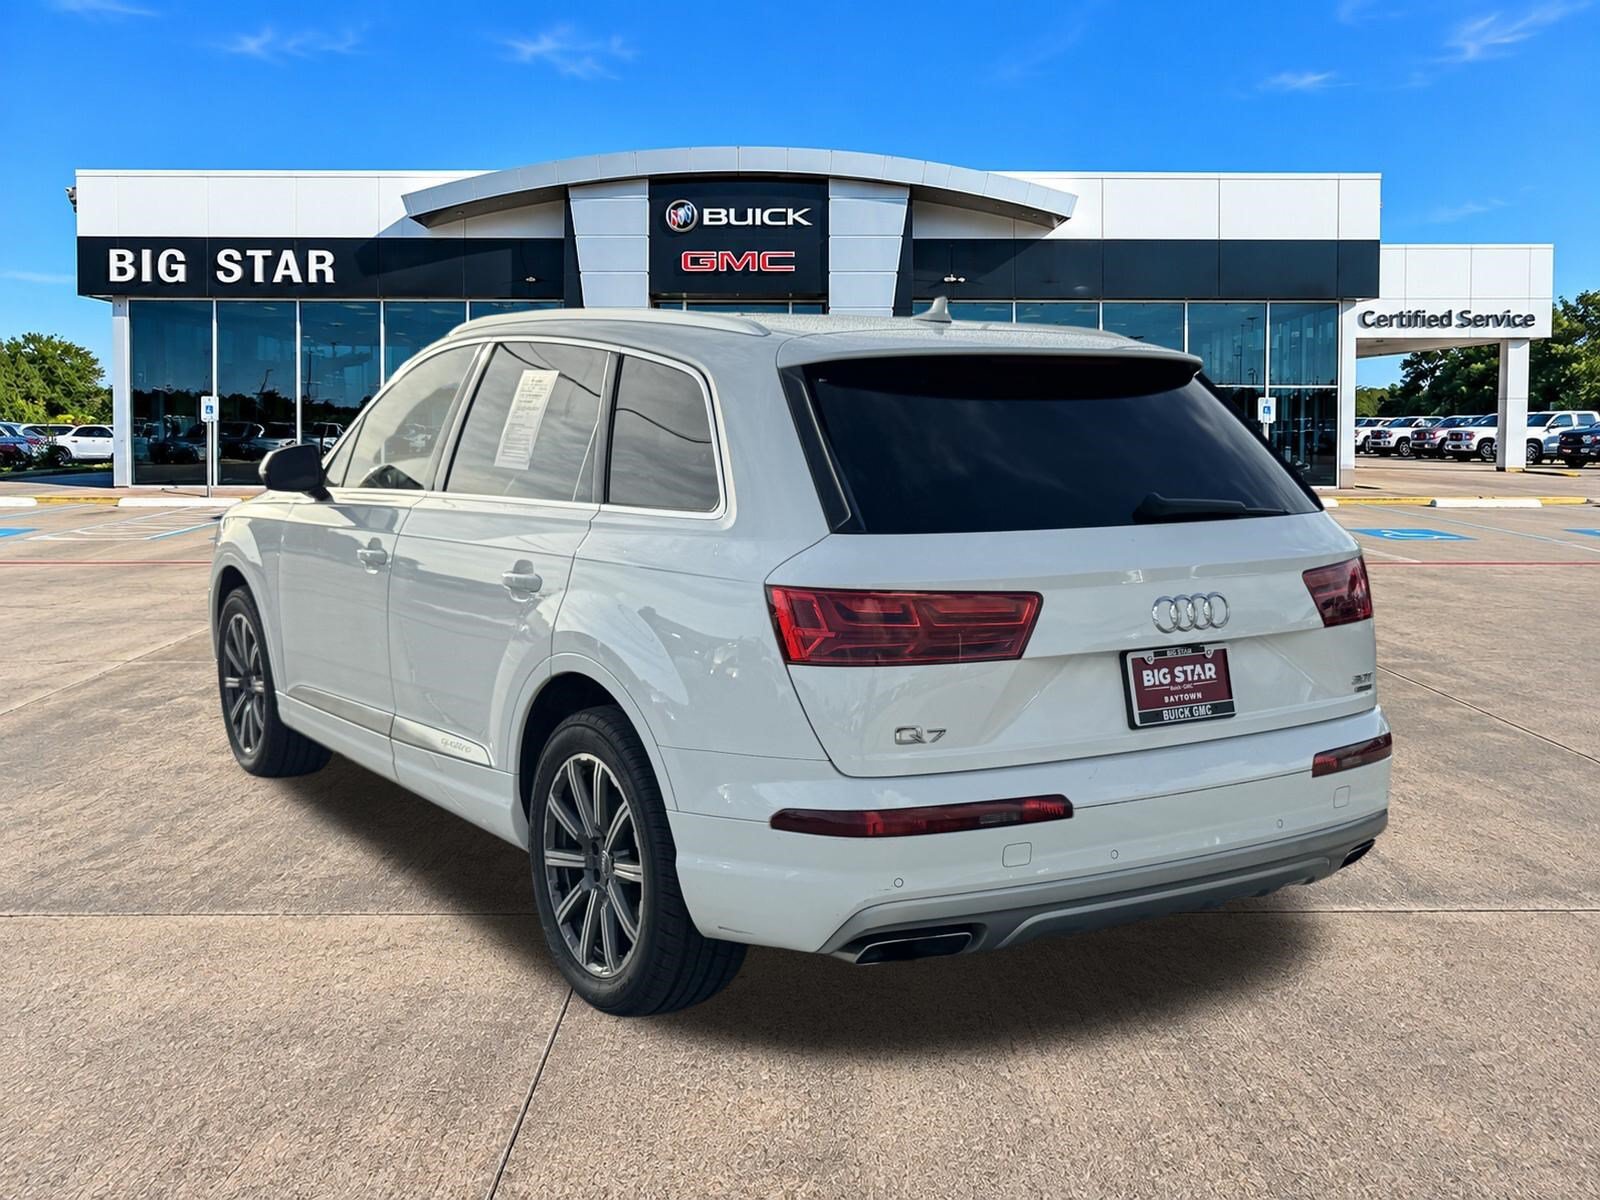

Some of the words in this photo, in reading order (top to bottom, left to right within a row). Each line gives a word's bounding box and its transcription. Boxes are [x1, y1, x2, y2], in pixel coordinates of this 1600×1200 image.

[703, 208, 813, 226] BUICK
[108, 248, 187, 283] BIG
[216, 248, 335, 283] STAR
[681, 251, 795, 272] GMC
[1360, 309, 1452, 328] Certified
[1457, 309, 1536, 328] Service
[1142, 667, 1171, 687] BIG
[1174, 663, 1216, 683] STAR
[1164, 692, 1202, 703] BAYTOWN
[1163, 707, 1191, 721] BUICK
[1192, 705, 1212, 718] GMC
[895, 725, 947, 745] Q7
